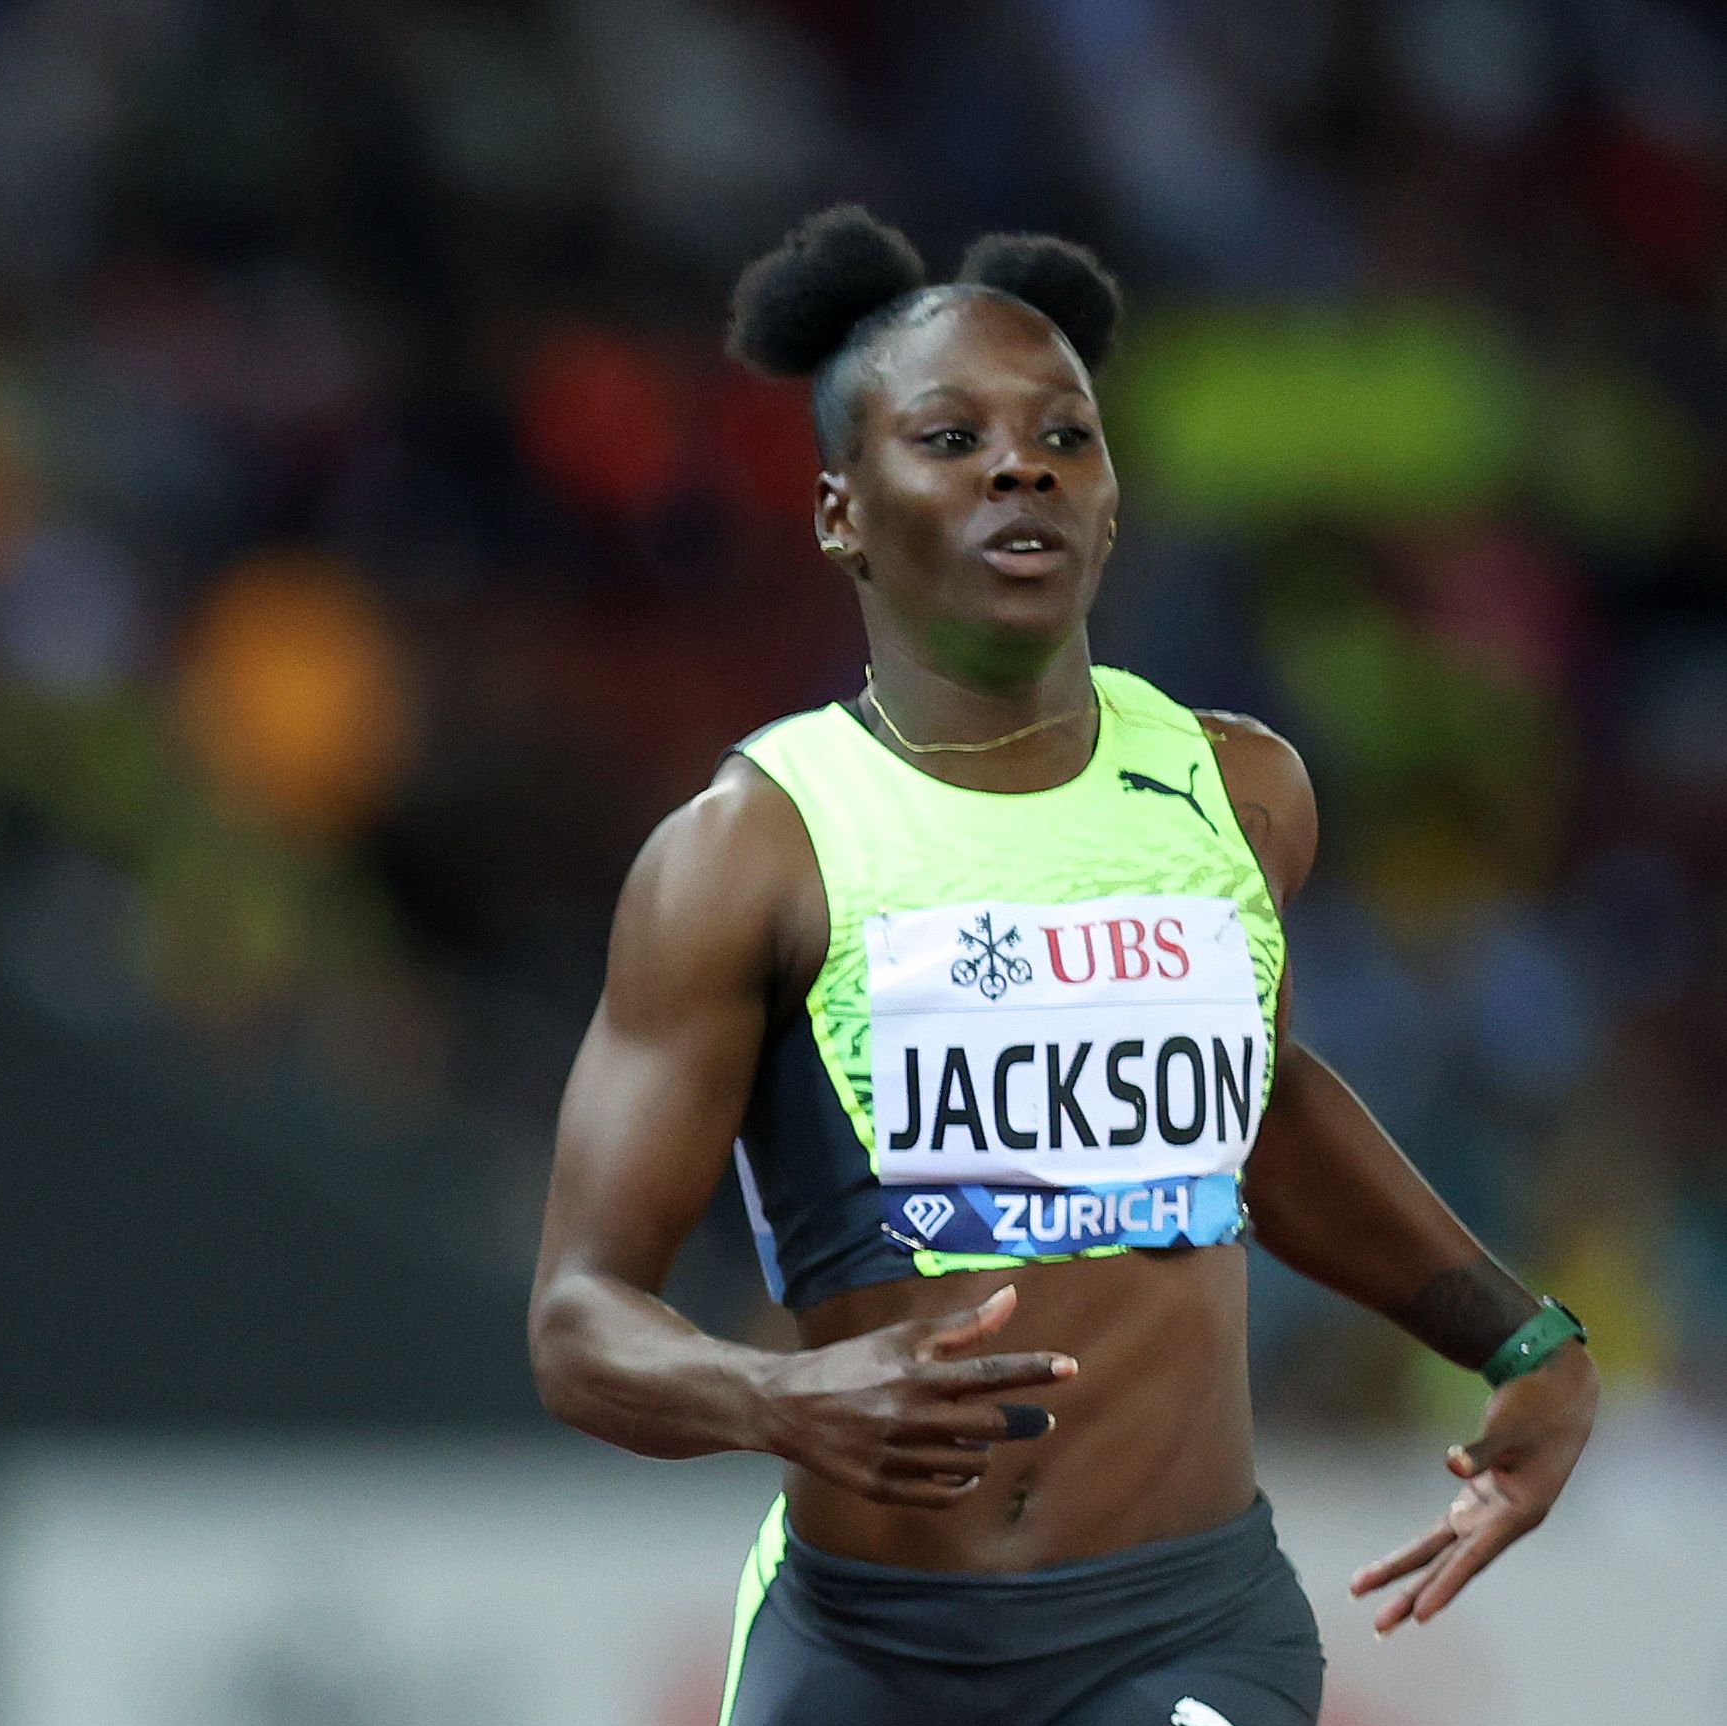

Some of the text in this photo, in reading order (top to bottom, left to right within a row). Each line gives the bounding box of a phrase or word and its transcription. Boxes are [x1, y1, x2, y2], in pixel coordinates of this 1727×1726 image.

[1039, 917, 1191, 984] UBS
[889, 1035, 1253, 1151] JACKSON
[993, 1185, 1190, 1242] ZURICH
